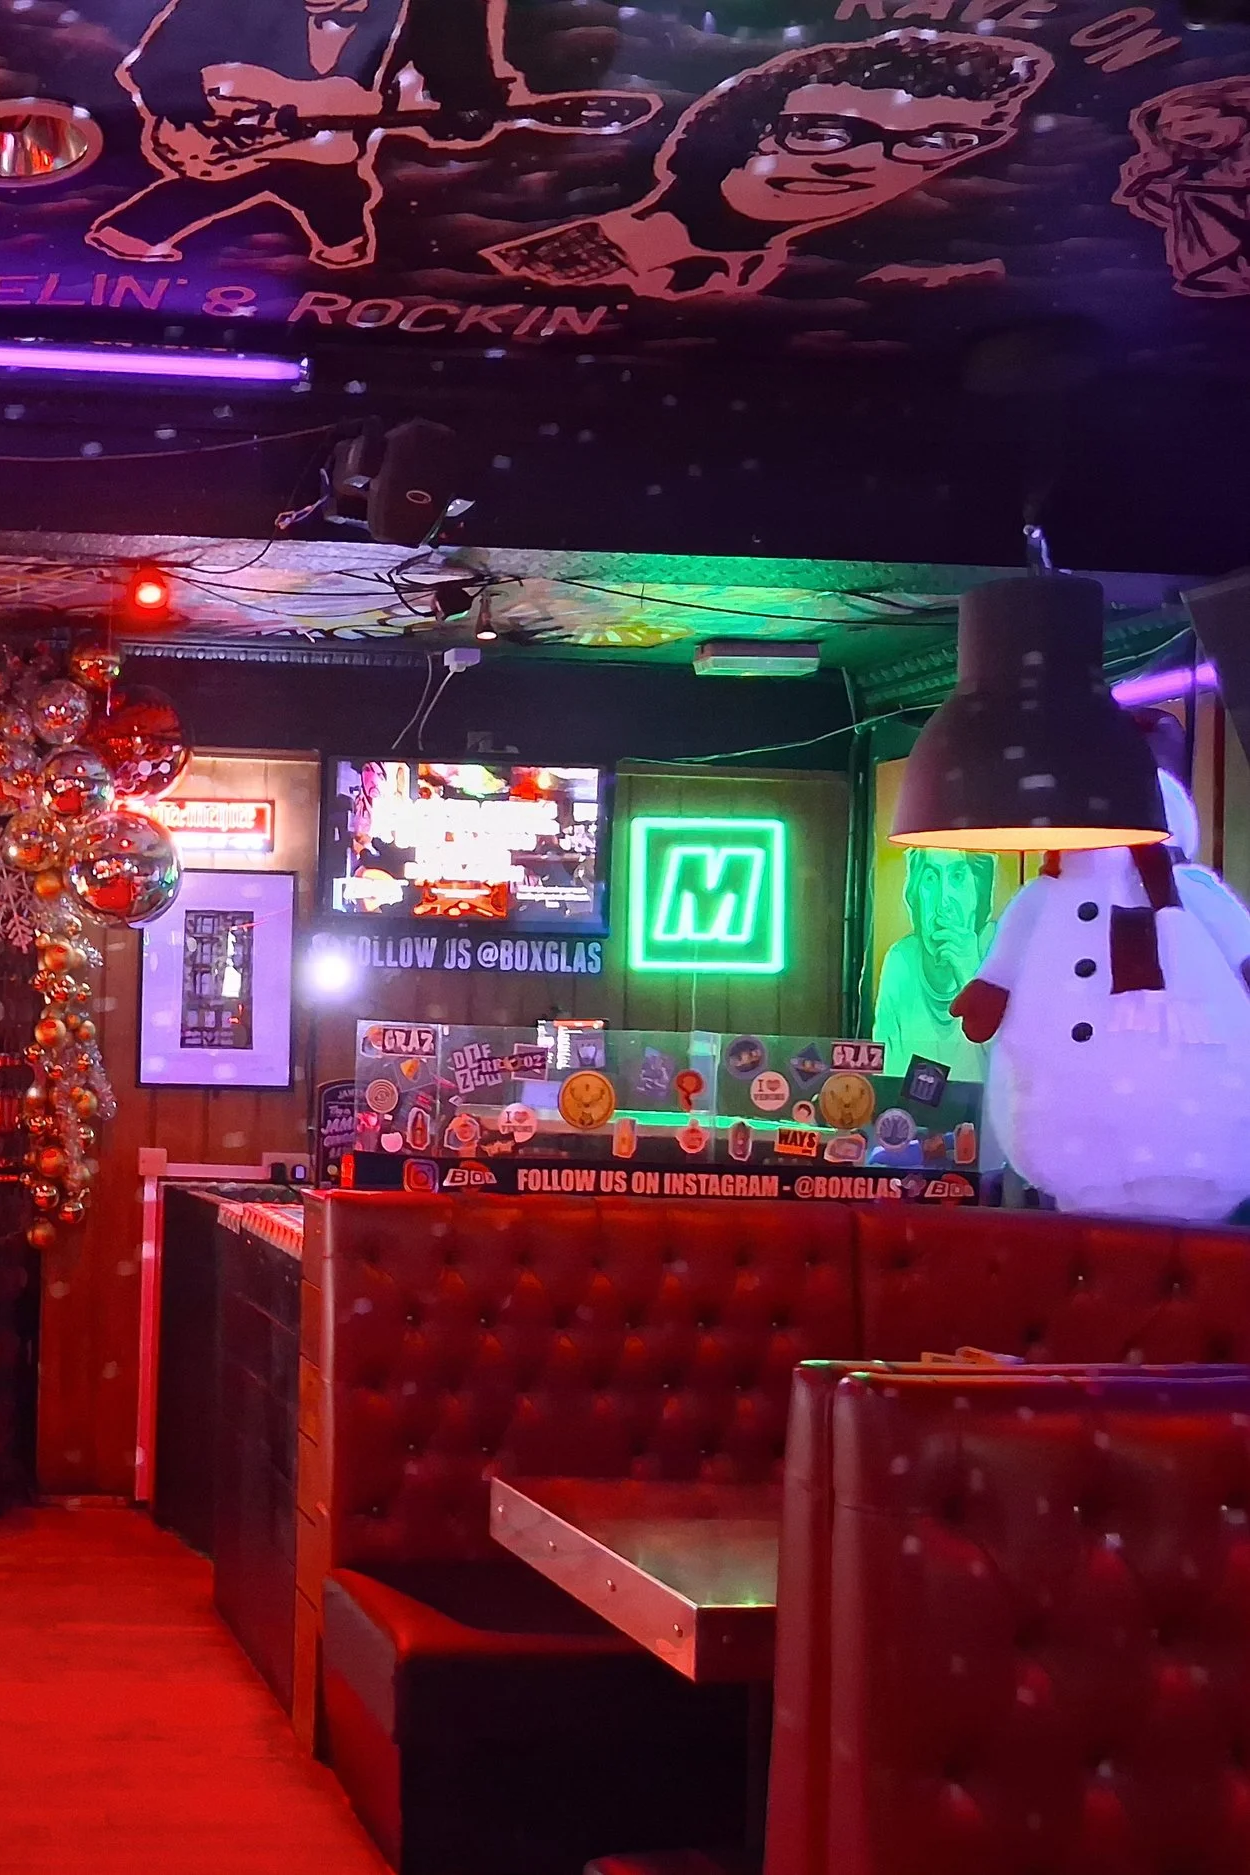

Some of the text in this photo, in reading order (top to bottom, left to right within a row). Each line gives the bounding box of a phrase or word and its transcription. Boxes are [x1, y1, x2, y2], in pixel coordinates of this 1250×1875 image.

[1069, 6, 1182, 73] ON
[202, 285, 257, 317] &
[653, 846, 767, 942] M
[443, 938, 472, 970] US
[477, 939, 602, 974] @BOXGLAS
[779, 1130, 817, 1148] WAYS
[517, 1169, 596, 1191] FOLLOW
[600, 1170, 628, 1192] US
[632, 1171, 660, 1194] ON
[664, 1173, 779, 1197] INSTAGRAM
[794, 1175, 902, 1199] @BOXGLAS
